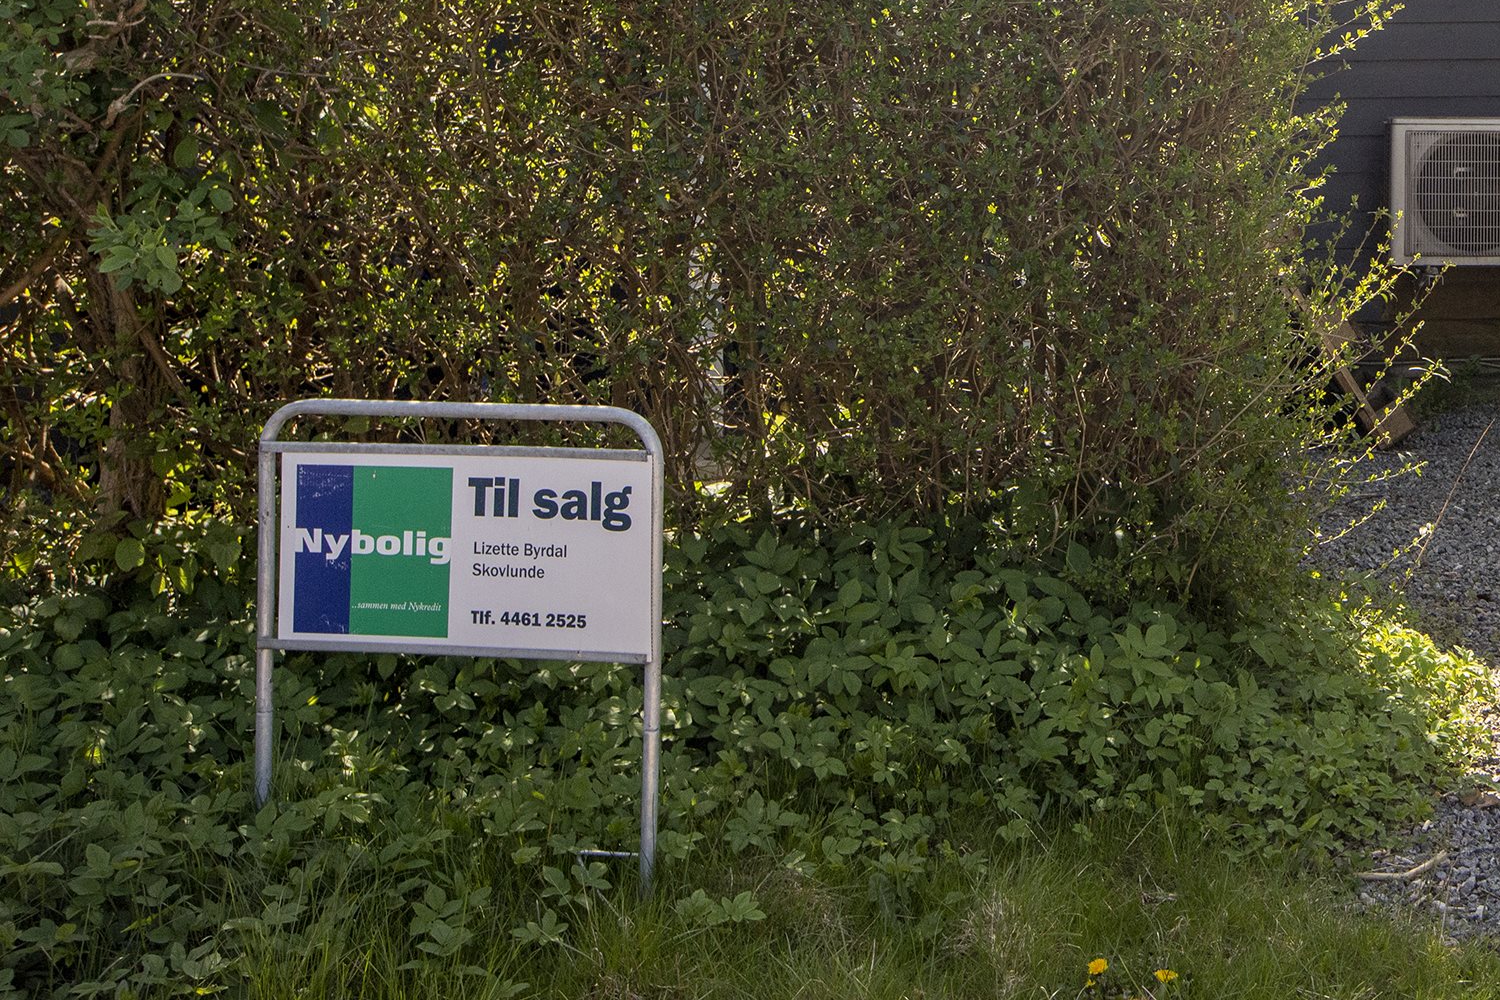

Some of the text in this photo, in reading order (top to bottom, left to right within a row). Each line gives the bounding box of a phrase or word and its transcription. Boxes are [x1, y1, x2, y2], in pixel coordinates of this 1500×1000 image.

[468, 477, 632, 531] Til salg
[295, 528, 452, 565] Nybolig
[473, 541, 567, 560] Lizette Byrdal
[472, 563, 545, 579] Skovlunde
[390, 602, 407, 610] med
[408, 602, 441, 612] Nykredit
[471, 610, 587, 629] Tlf. 4461 2525
